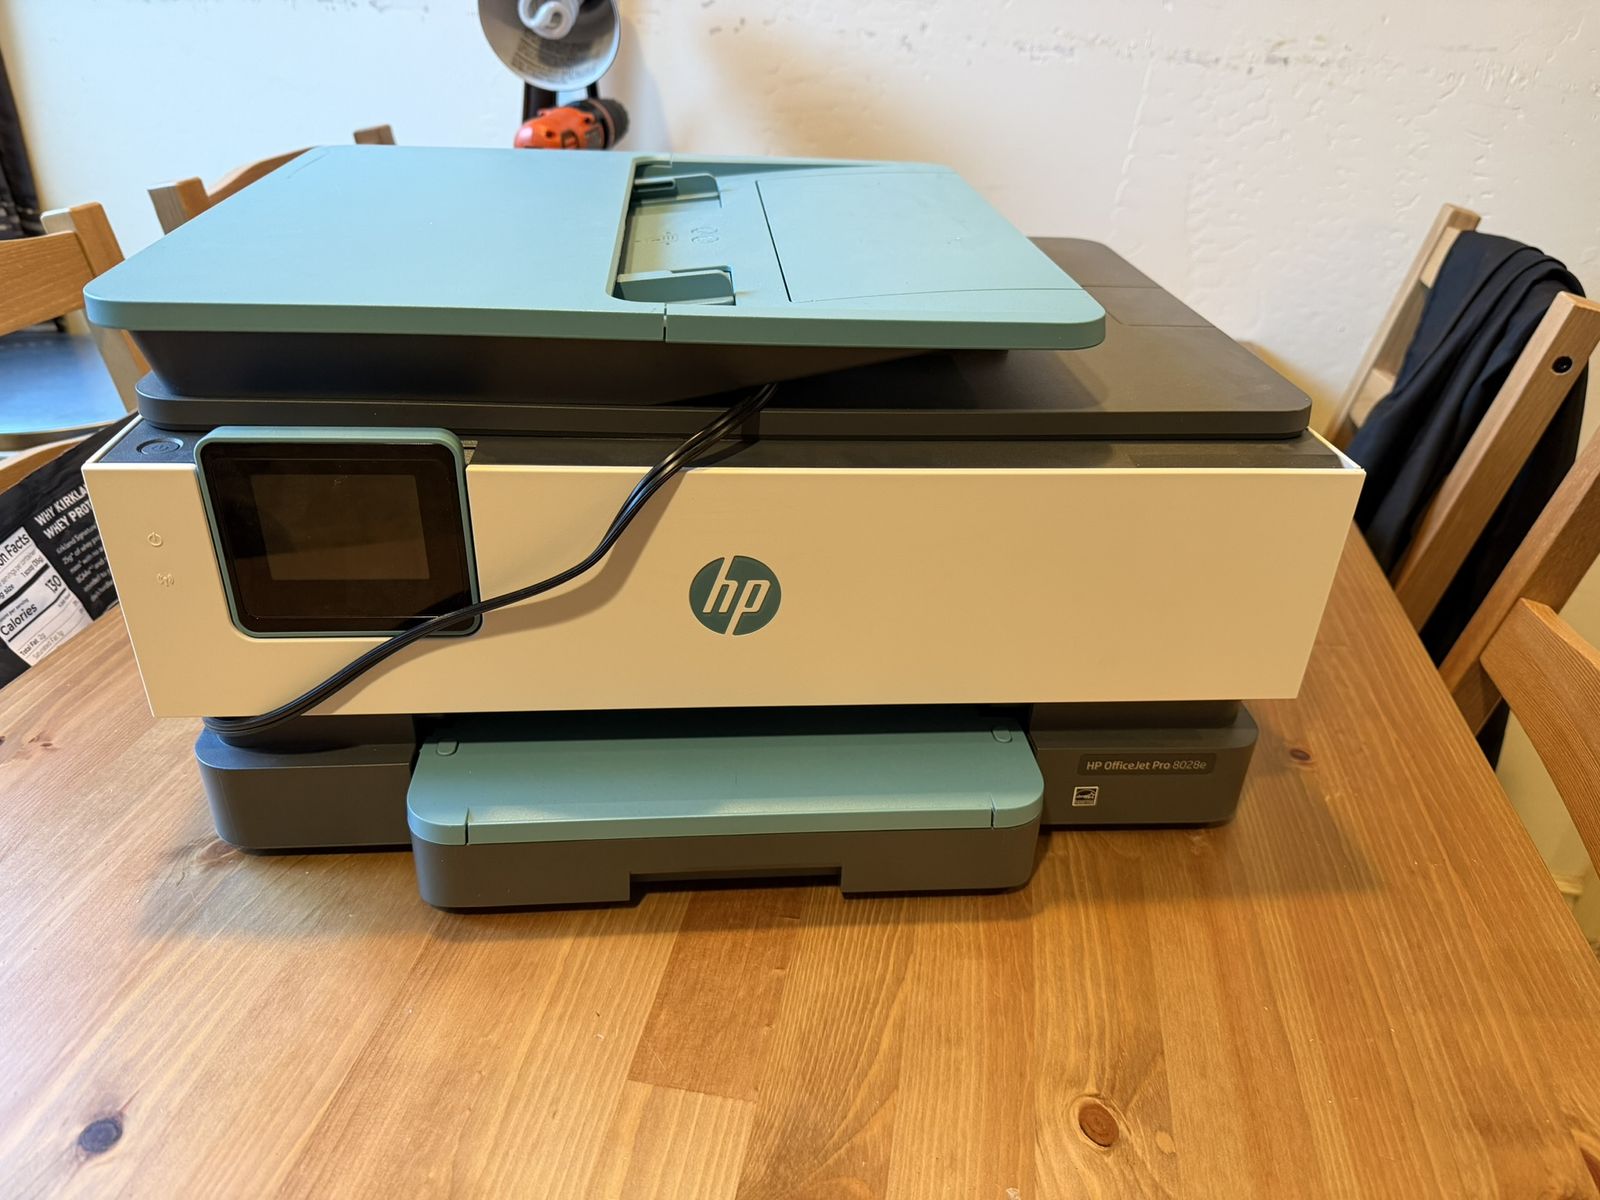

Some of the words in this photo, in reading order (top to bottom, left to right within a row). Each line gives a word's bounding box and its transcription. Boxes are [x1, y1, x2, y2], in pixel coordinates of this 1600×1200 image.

[33, 505, 55, 526] WHY
[53, 484, 88, 513] KIRKLA
[43, 515, 70, 539] WHEY
[68, 500, 92, 522] PROT
[4, 534, 30, 557] Facts
[45, 575, 62, 593] 130
[701, 555, 772, 635] hp
[0, 603, 37, 636] Calories
[1086, 761, 1102, 770] HP
[1104, 760, 1150, 770] OfficeJet
[1152, 761, 1170, 770] Pro
[1172, 760, 1207, 770] 8028e
